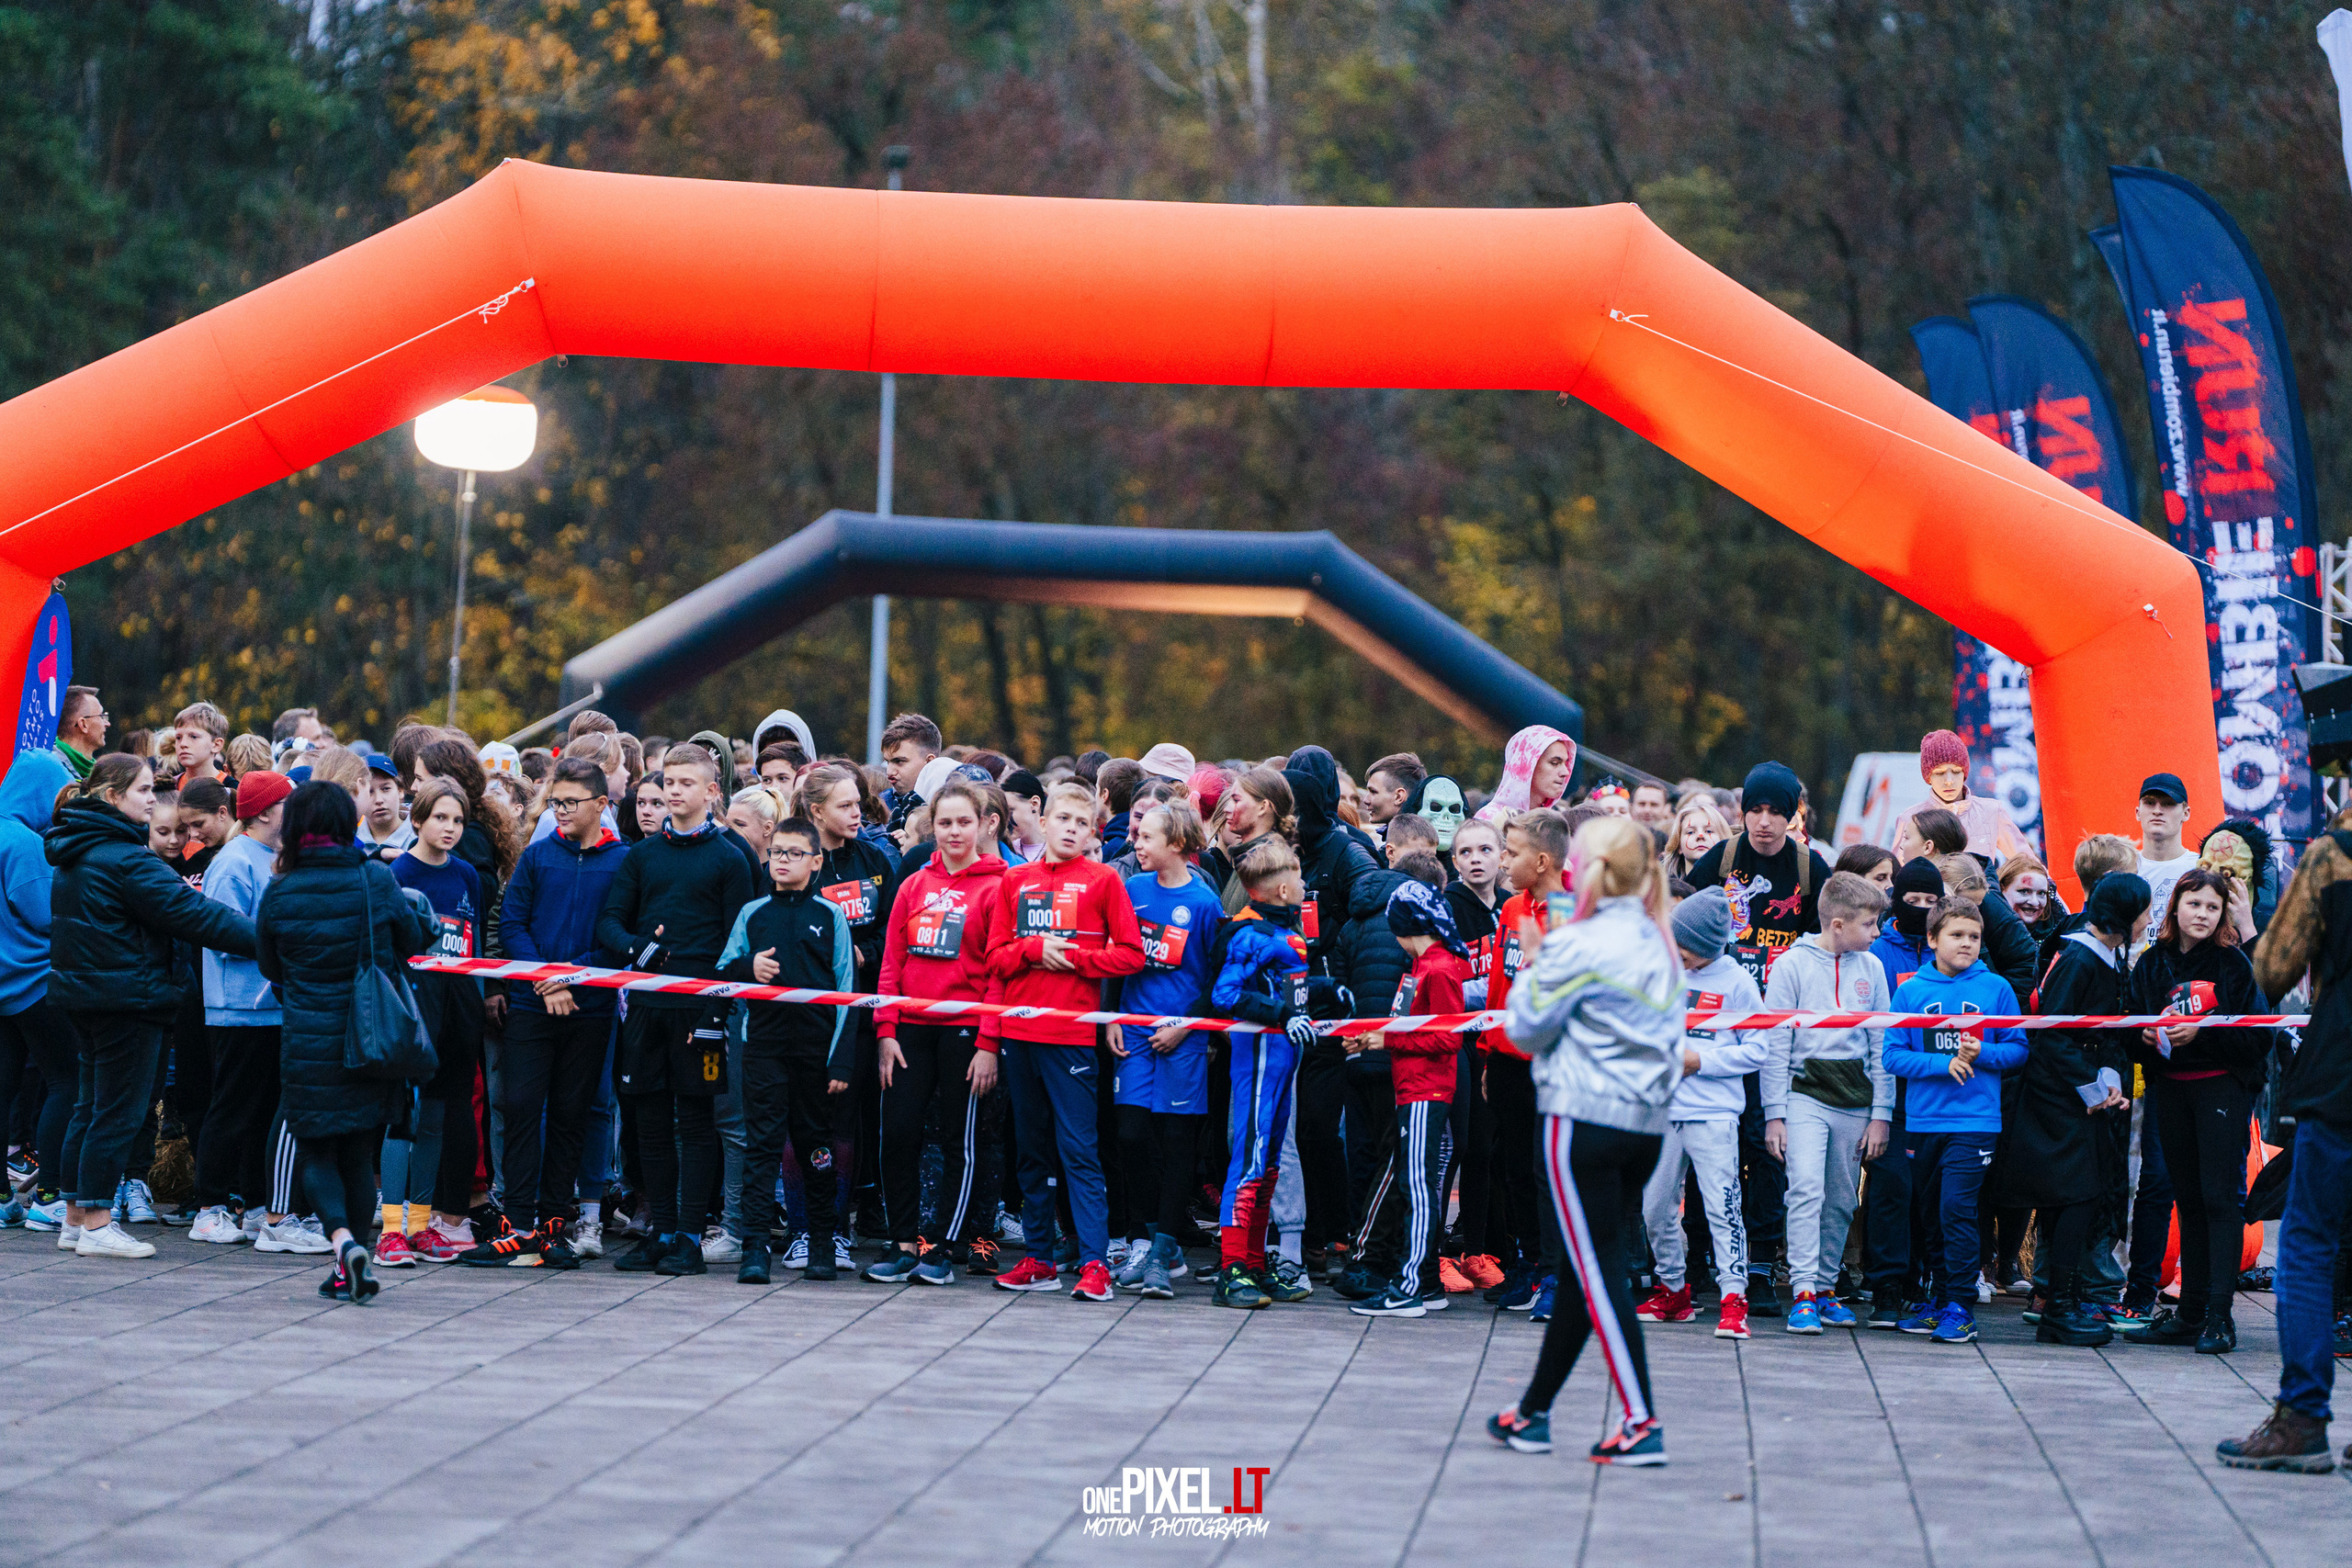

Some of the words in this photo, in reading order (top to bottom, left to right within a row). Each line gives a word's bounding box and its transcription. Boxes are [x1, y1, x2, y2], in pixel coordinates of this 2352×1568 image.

[840, 897, 872, 917] 0752
[1027, 908, 1061, 928] 0001
[442, 933, 469, 955] 0004
[917, 926, 948, 946] 0811
[1470, 953, 1493, 974] 078
[1505, 948, 1525, 967] 000
[1294, 987, 1308, 1007] 06
[704, 1051, 719, 1081] 8
